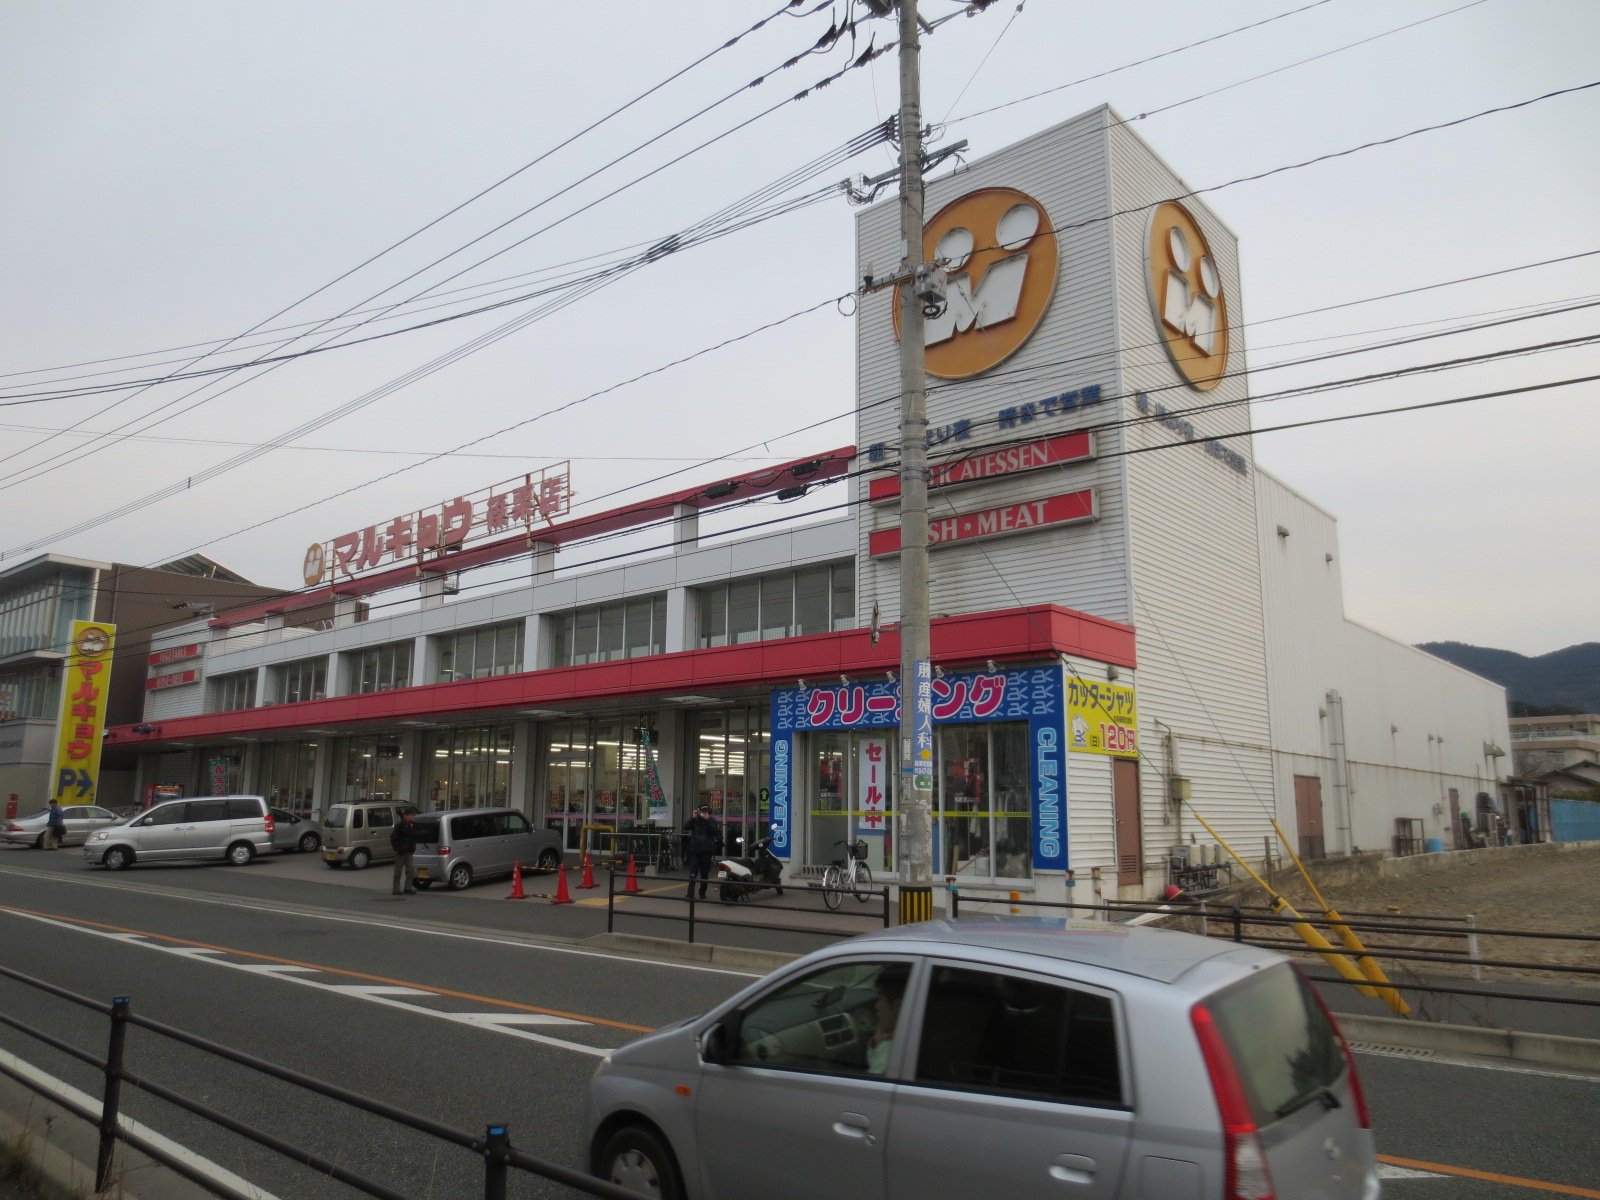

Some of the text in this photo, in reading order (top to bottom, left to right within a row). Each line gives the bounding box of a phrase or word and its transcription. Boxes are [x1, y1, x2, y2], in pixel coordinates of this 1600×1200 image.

[334, 497, 474, 576] マルキョウ
[978, 500, 1049, 536] MEAT
[66, 660, 104, 761] マルキョウ
[807, 675, 1007, 727] クリーング
[1099, 723, 1137, 752] 120円
[57, 768, 77, 797] P
[773, 739, 789, 848] CLEANING
[865, 742, 883, 829] セール中
[1038, 722, 1060, 858] CLEANING
